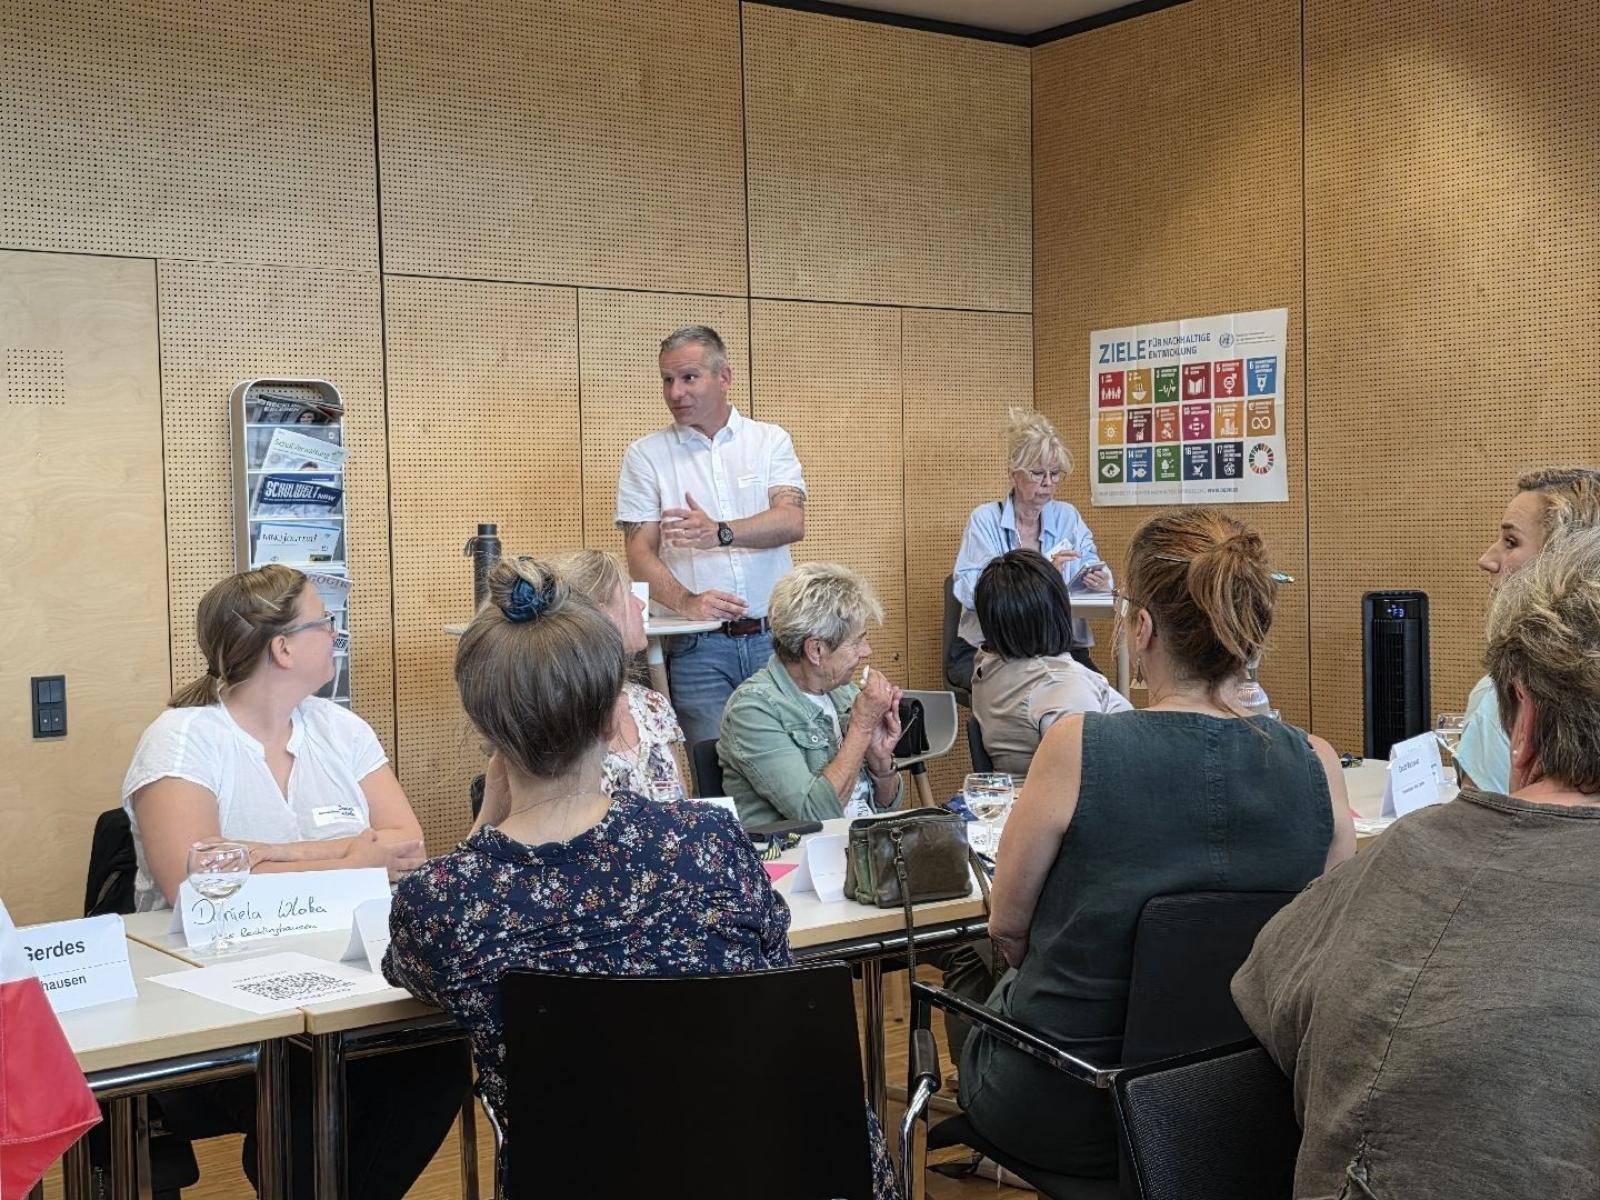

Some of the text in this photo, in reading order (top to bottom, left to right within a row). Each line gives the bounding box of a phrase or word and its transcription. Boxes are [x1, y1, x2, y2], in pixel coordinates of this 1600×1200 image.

[1099, 333, 1211, 364] ZIELE FÜR NACHHALTIGE
[1148, 346, 1198, 359] ENTWICKLUNG
